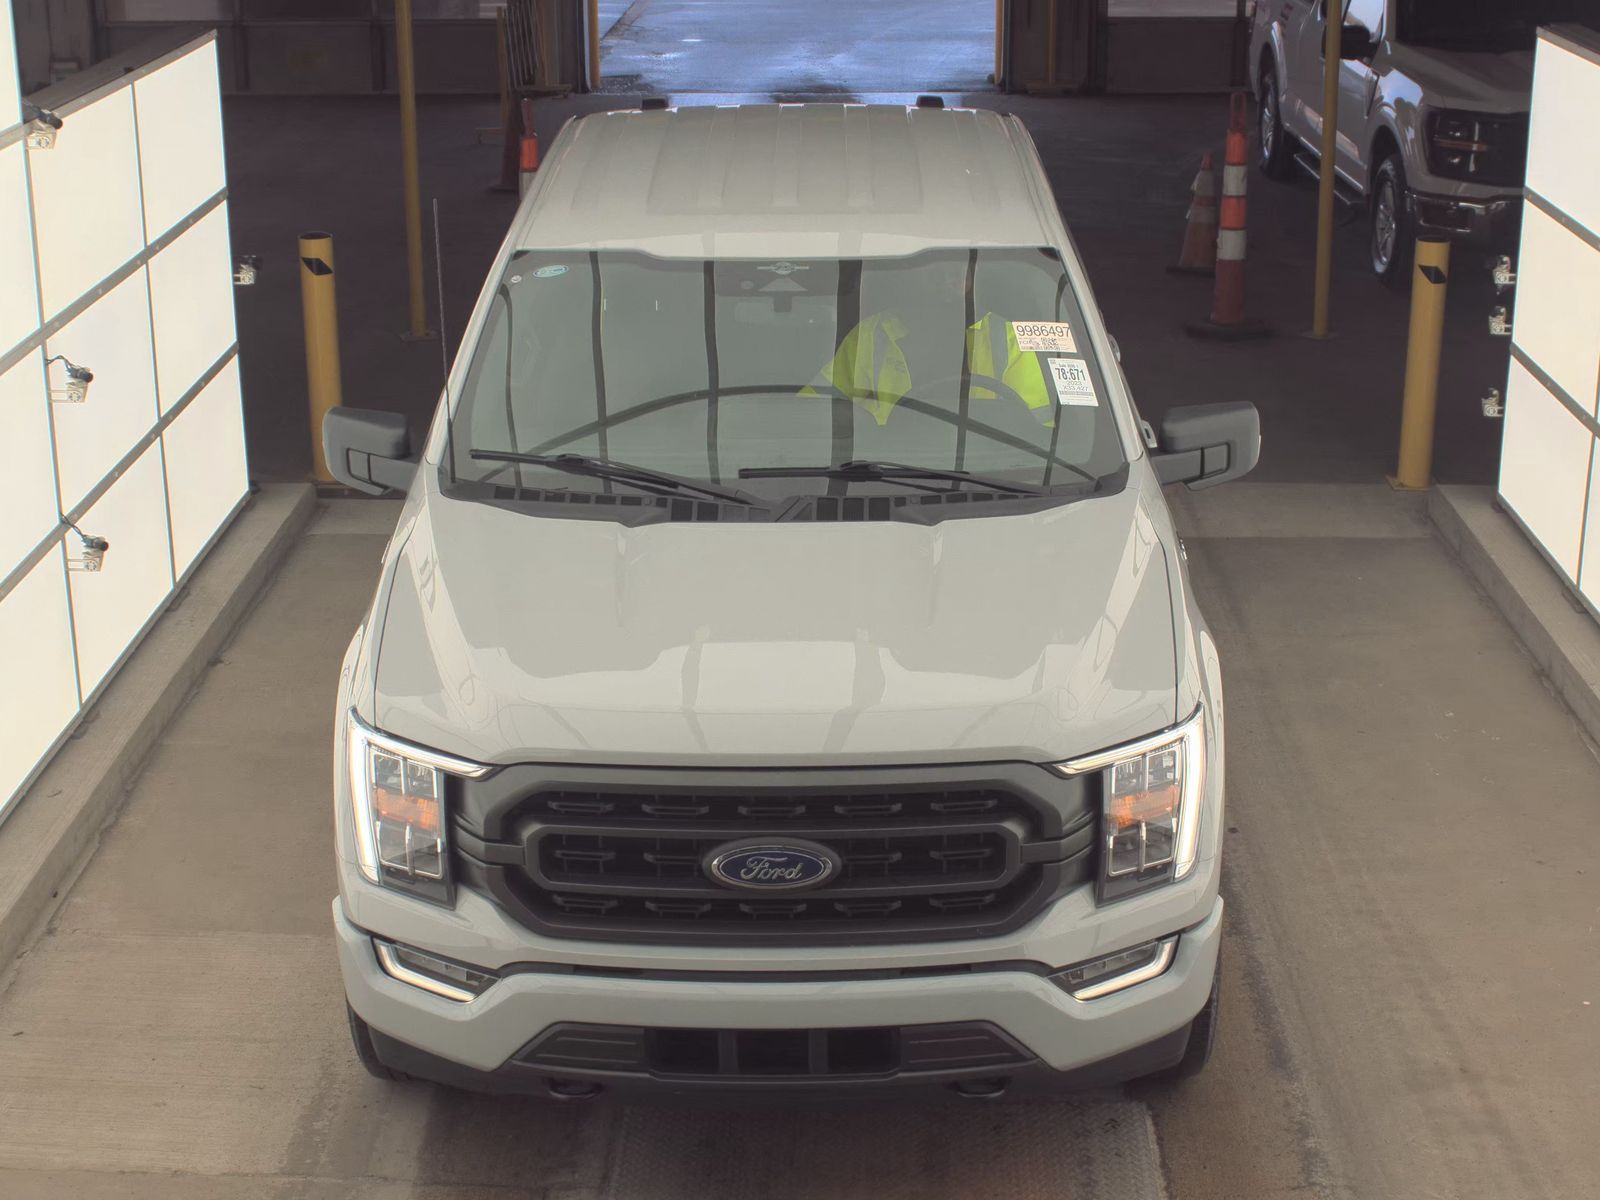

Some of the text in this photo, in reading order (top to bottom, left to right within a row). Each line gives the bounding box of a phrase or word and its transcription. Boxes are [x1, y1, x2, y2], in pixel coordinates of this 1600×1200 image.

[1016, 325, 1071, 337] 9986497
[1055, 367, 1086, 381] 78:671
[740, 856, 803, 880] Ford
